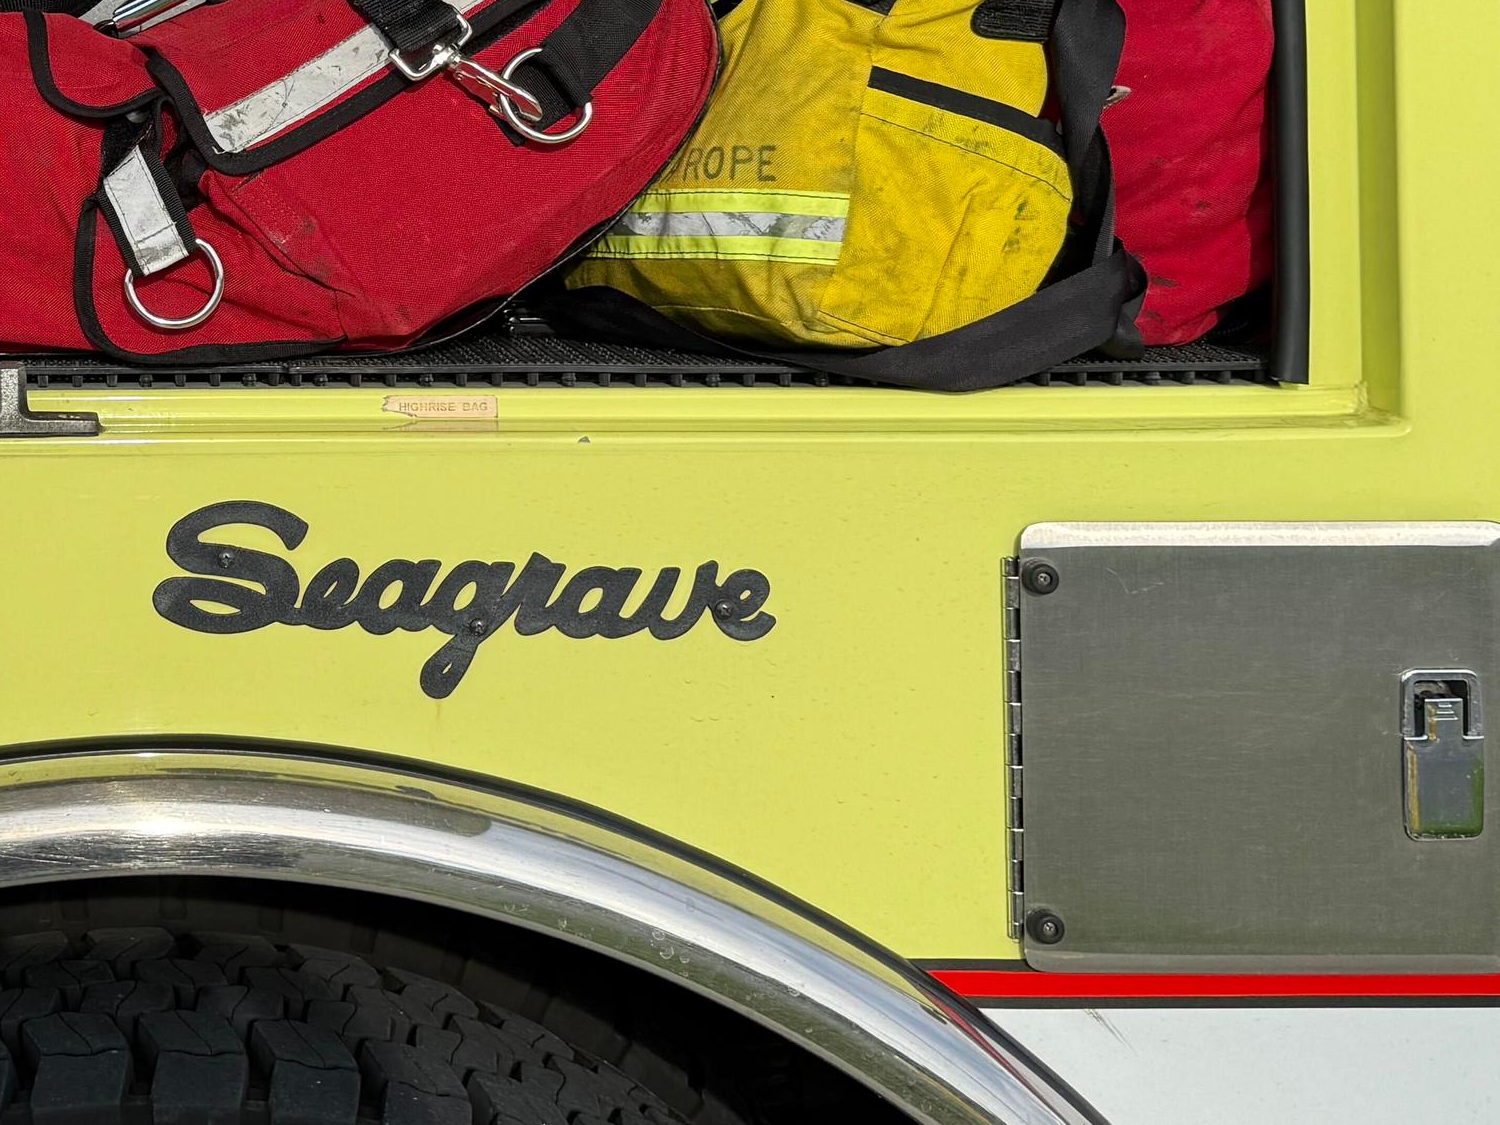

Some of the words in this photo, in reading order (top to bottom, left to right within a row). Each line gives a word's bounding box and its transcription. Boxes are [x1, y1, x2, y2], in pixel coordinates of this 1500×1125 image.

[682, 144, 776, 182] ROPE
[399, 402, 456, 412] HIGHRISE
[462, 402, 488, 412] BAG
[152, 500, 777, 699] Seagrave
